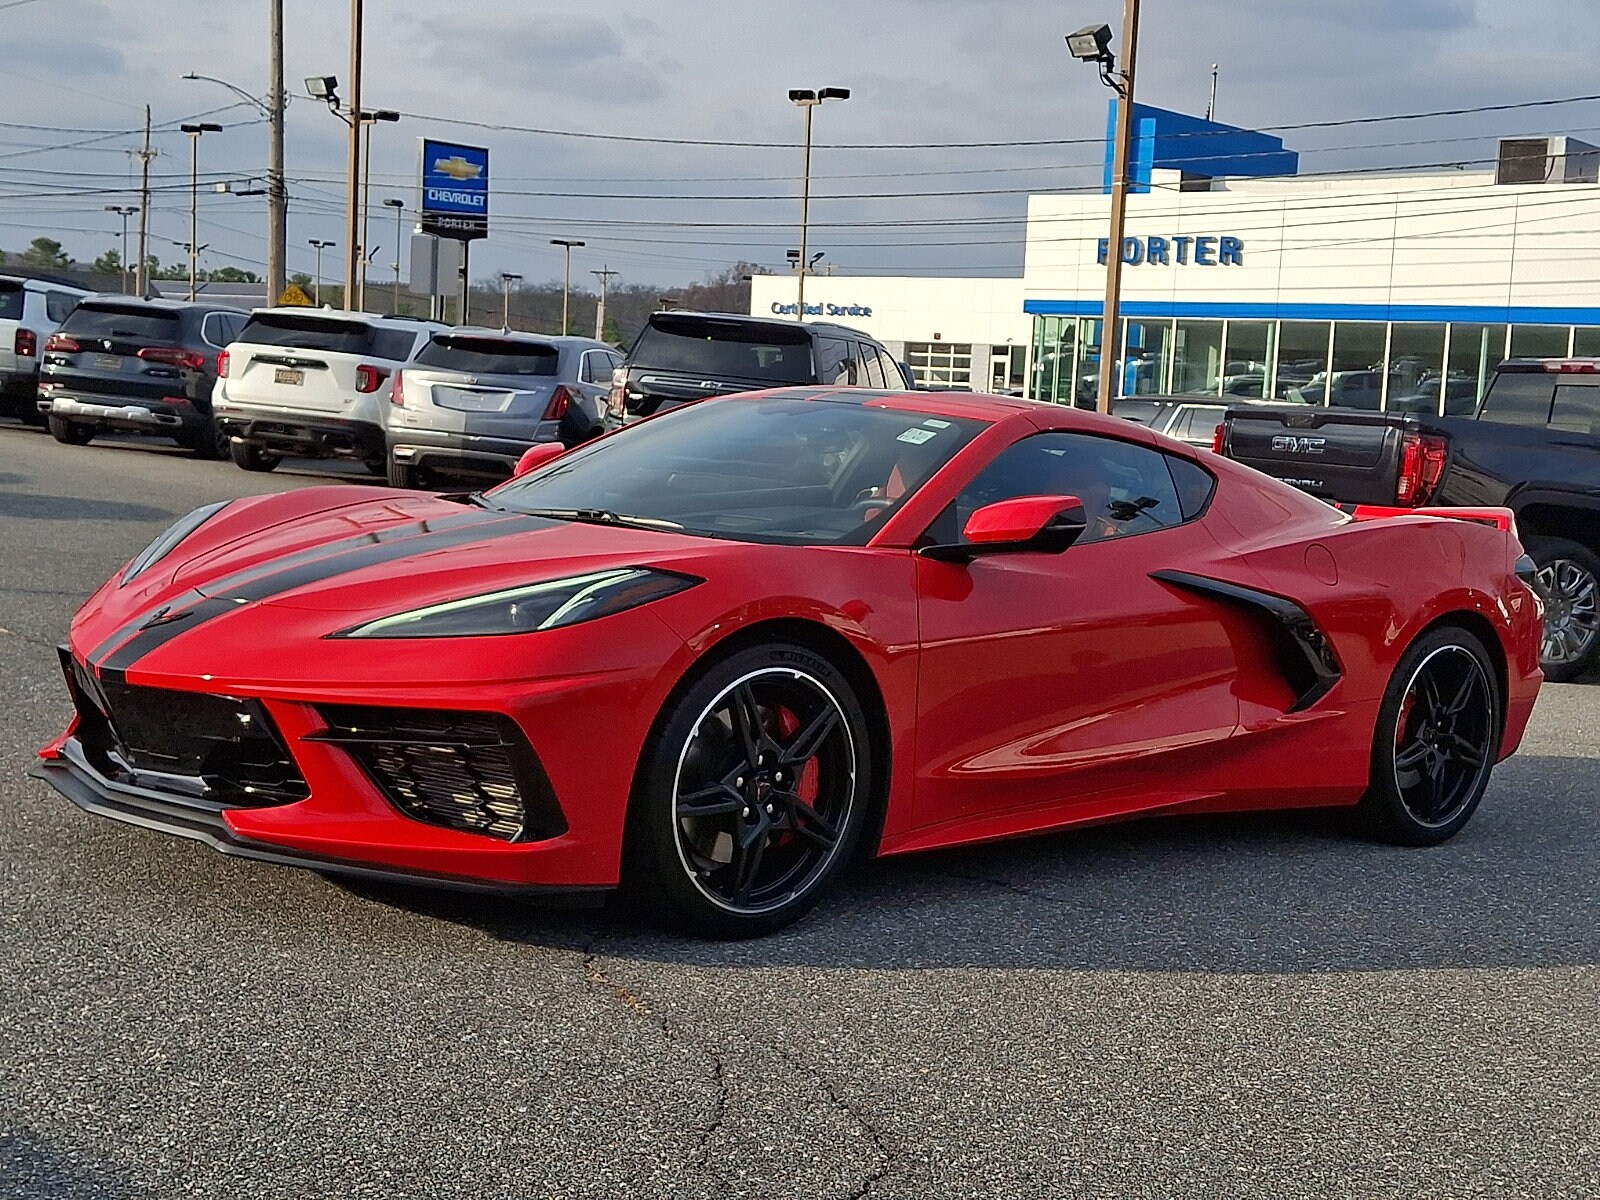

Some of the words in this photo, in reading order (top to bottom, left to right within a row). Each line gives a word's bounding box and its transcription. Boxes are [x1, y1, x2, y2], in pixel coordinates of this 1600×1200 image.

[428, 189, 485, 206] CHEVROLET
[1097, 236, 1244, 266] PORTER
[826, 303, 872, 317] Service
[1272, 436, 1326, 454] GMC
